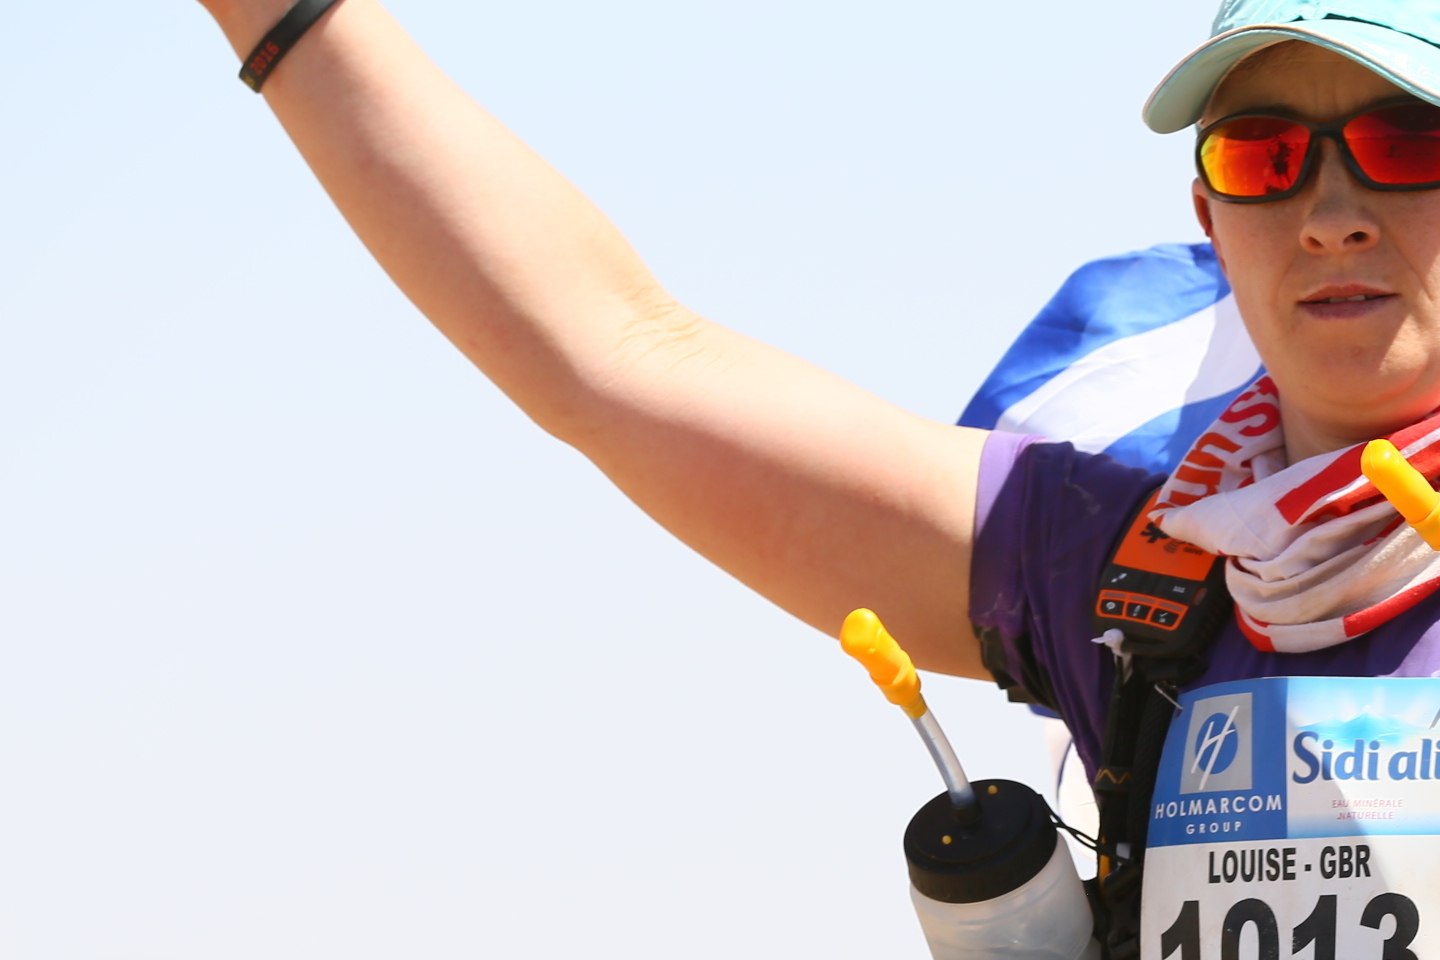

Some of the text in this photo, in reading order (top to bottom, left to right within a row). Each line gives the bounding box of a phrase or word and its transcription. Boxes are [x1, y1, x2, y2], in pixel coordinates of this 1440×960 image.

[1292, 731, 1380, 785] Sidi
[1154, 794, 1283, 820] HOLMARCOM
[1332, 797, 1404, 808] EAU MINÉRALE
[1338, 811, 1394, 820] NATURELLE
[1185, 821, 1242, 835] GROUP
[1208, 847, 1297, 884] LOUISE
[1319, 844, 1372, 880] GBR
